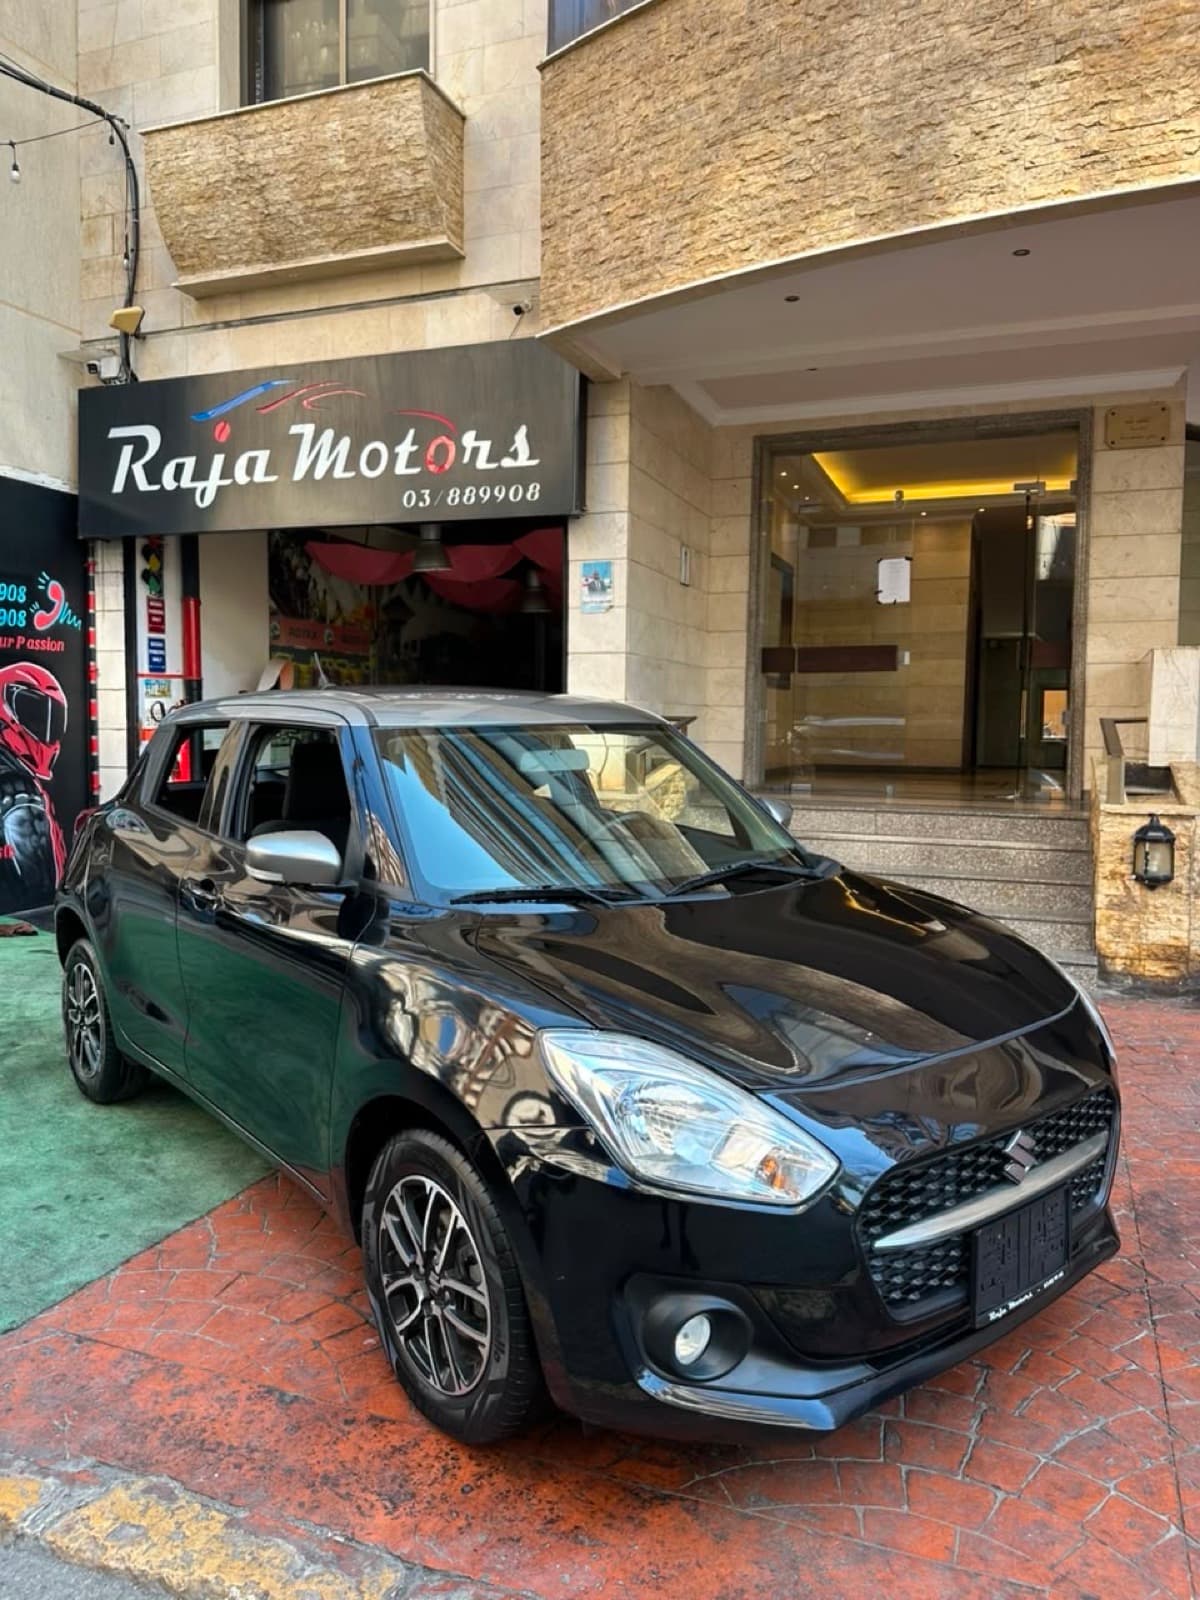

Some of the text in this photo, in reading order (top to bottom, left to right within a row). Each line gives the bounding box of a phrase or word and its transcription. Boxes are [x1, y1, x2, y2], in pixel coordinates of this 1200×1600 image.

[108, 420, 541, 508] Raja Motors
[403, 482, 541, 508] 03/889908
